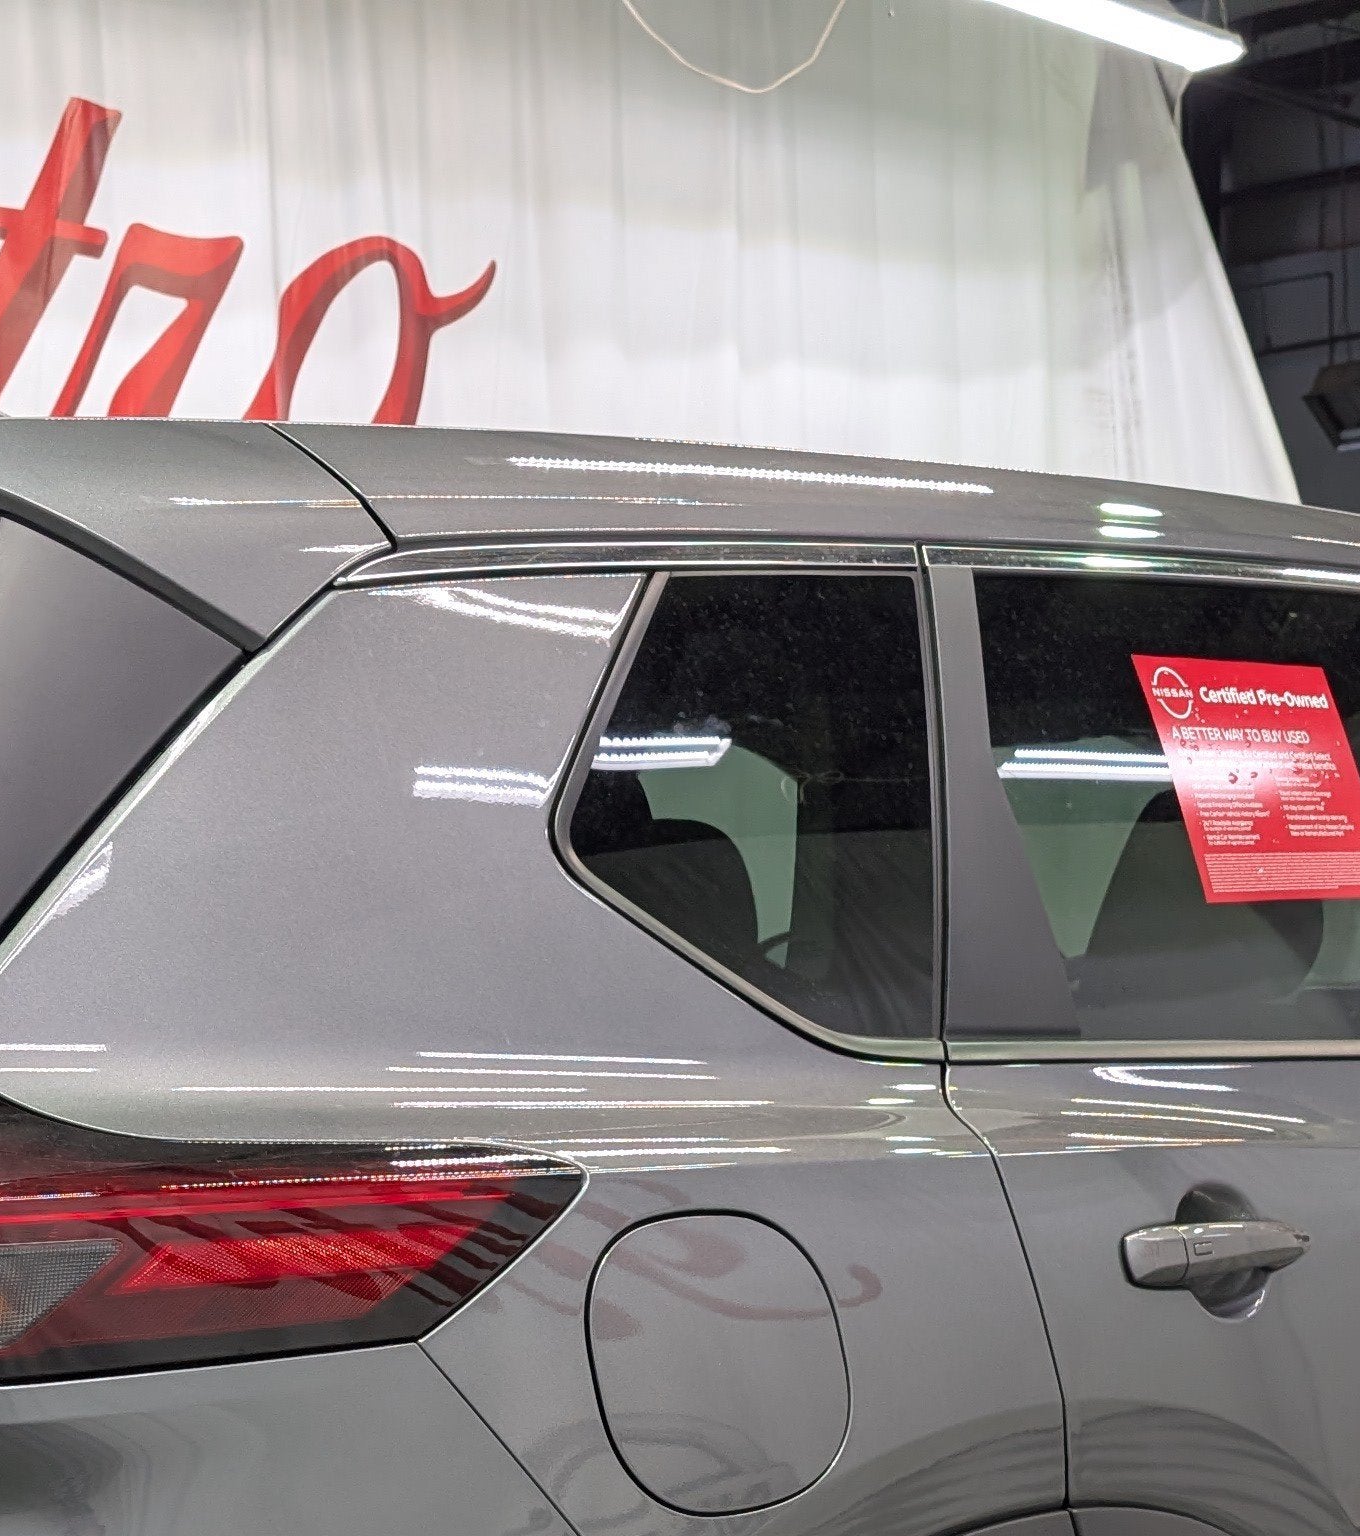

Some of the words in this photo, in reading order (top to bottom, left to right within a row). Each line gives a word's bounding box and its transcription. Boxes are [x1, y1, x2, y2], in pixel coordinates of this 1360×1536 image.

[1151, 687, 1194, 699] NISSAN
[1199, 686, 1254, 706] Certified
[1257, 689, 1329, 709] Pre-Owned
[1171, 726, 1180, 739] A
[1180, 727, 1222, 741] BETTER
[1222, 728, 1244, 741] WAY
[1246, 729, 1262, 743] TO
[1262, 730, 1283, 743] BUY
[1284, 731, 1310, 744] USED
